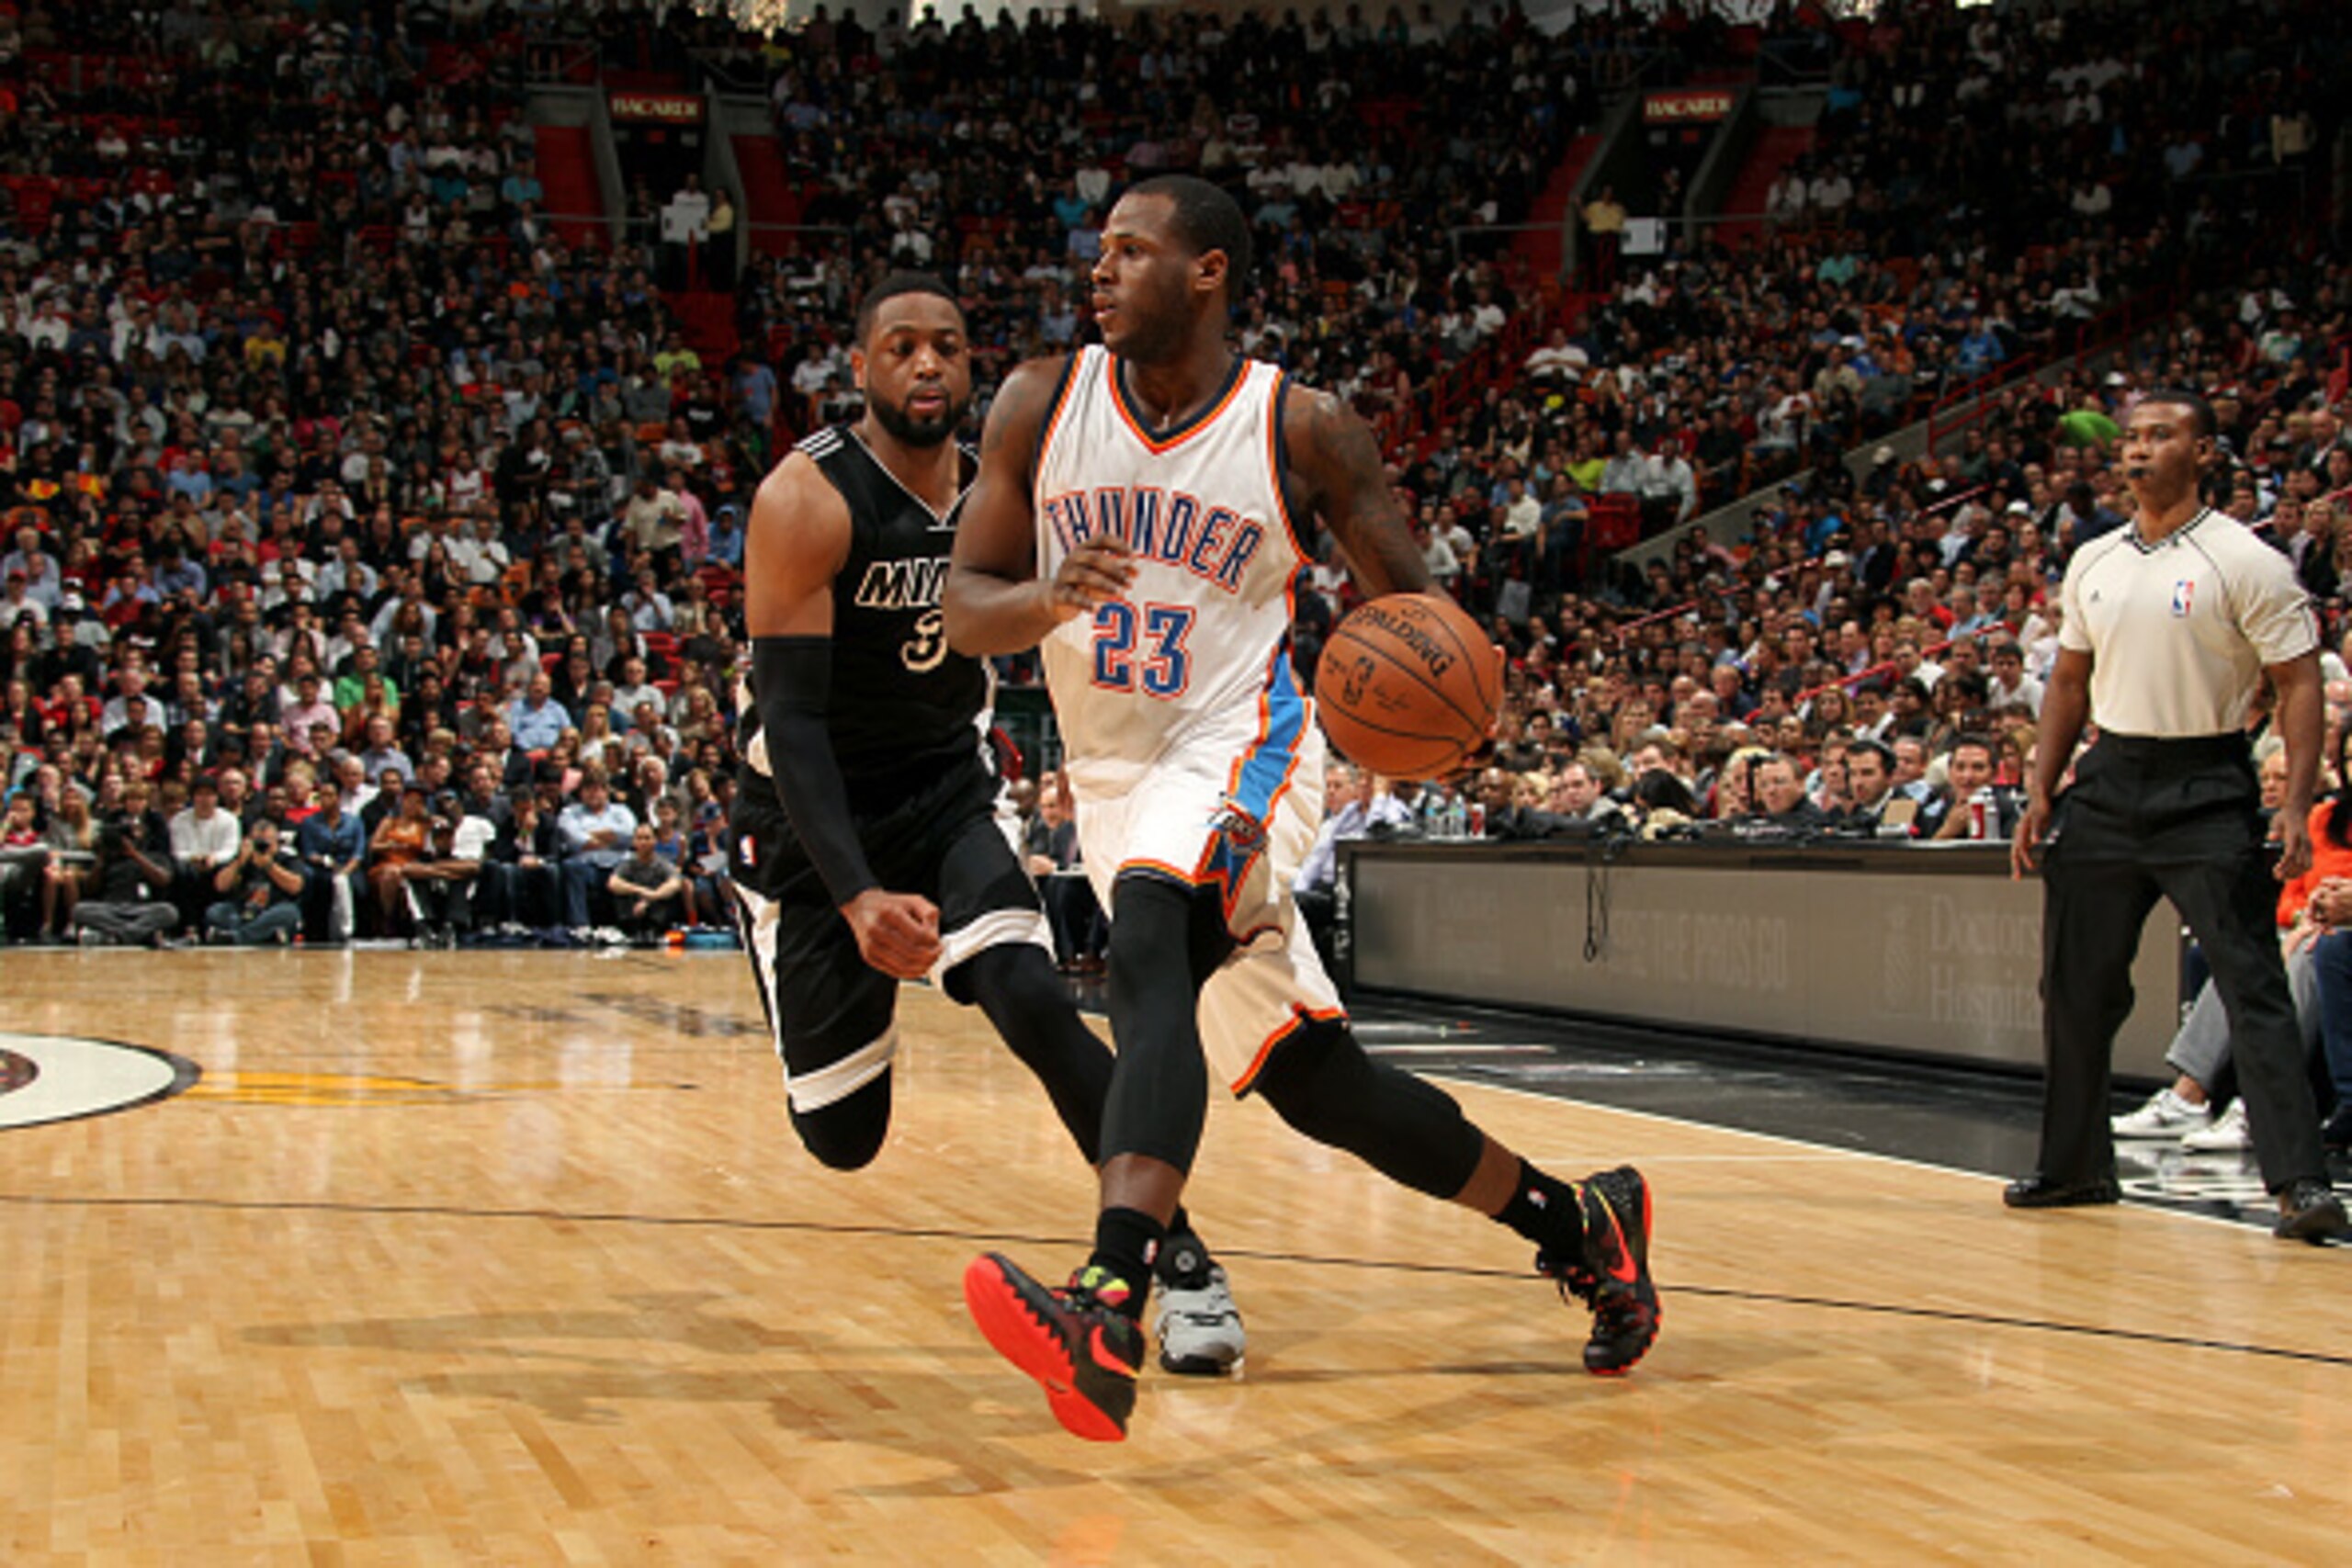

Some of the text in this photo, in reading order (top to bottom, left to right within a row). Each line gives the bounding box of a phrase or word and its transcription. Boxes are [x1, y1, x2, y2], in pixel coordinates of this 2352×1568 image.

[1043, 486, 1264, 595] THUNDER
[900, 608, 948, 673] 3
[1091, 598, 1197, 701] 23
[1347, 605, 1455, 679] SPALDING
[1930, 963, 2041, 1045] Hospita
